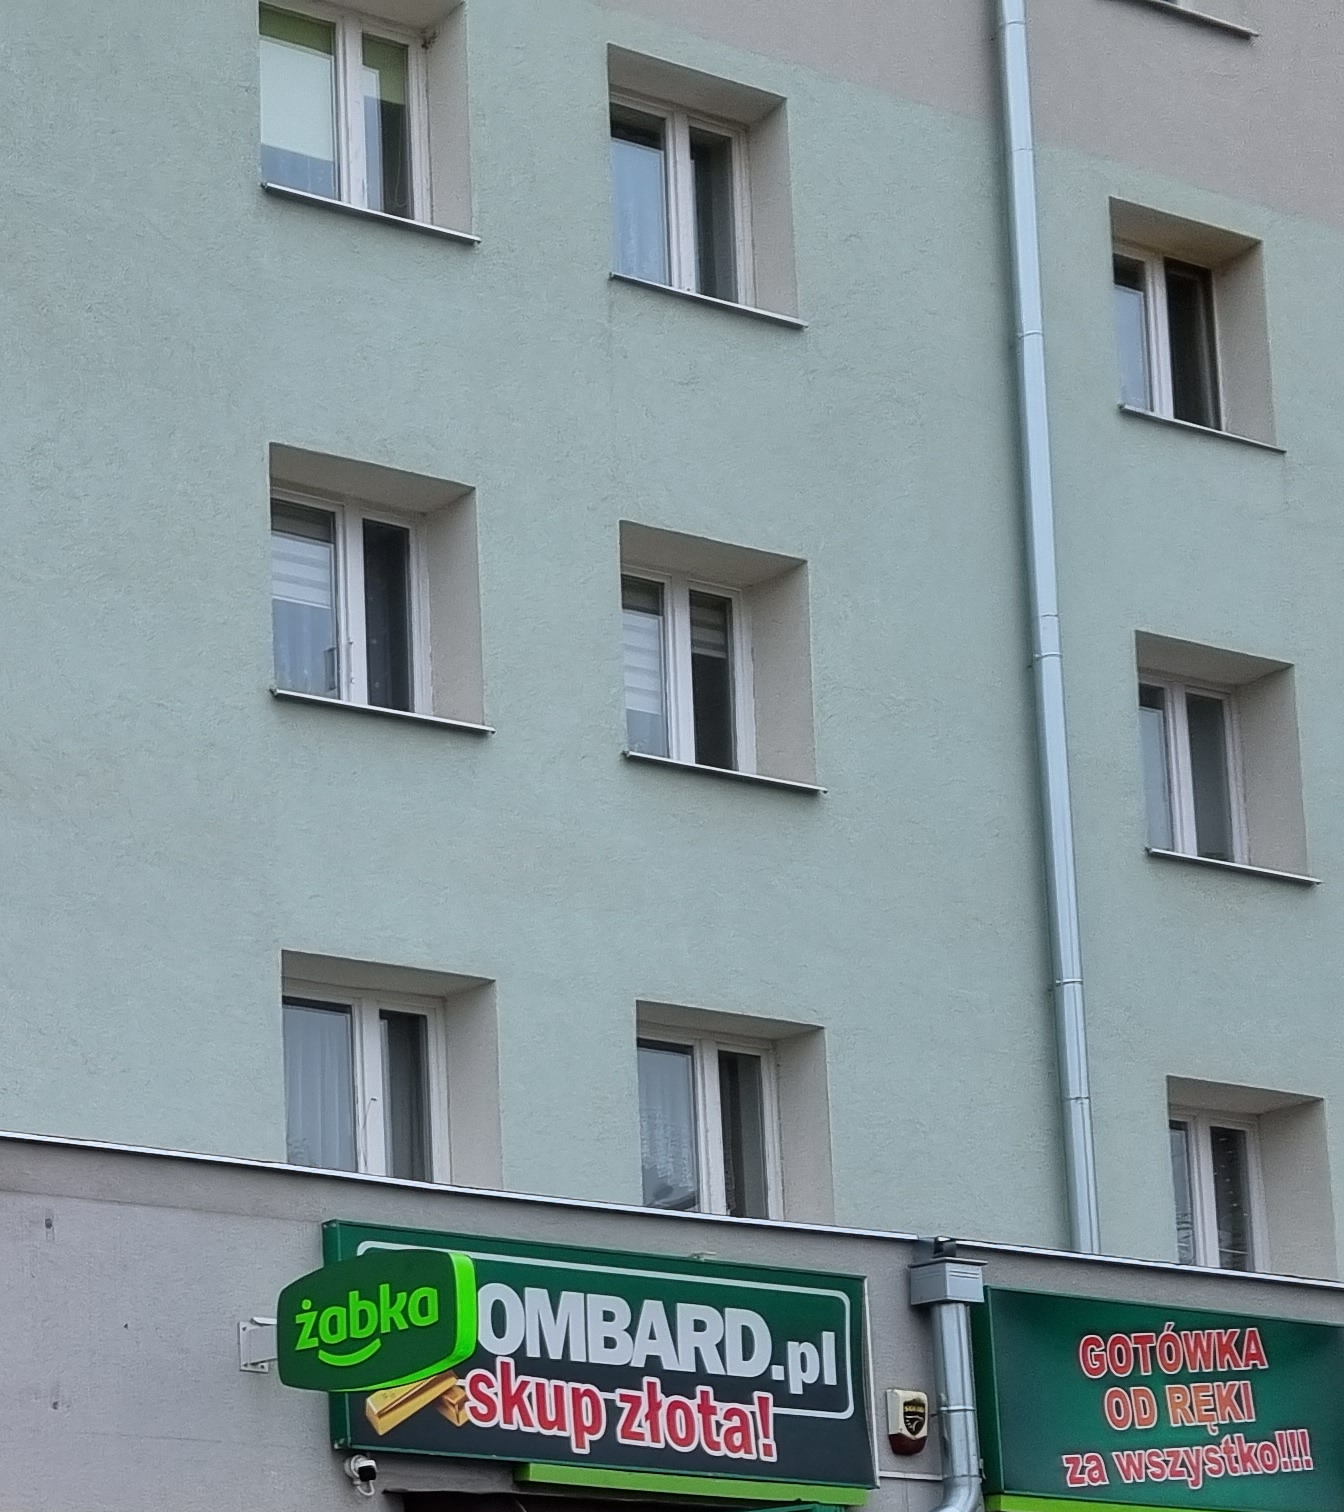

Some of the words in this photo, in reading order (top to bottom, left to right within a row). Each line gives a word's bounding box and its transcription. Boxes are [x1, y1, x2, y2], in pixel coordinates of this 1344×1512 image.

[296, 1283, 439, 1352] żabka
[477, 1283, 838, 1394] OMBARD.pl
[1080, 1322, 1268, 1378] GOTÓWKA
[465, 1357, 606, 1454] skup
[615, 1377, 778, 1463] złota!
[1104, 1386, 1157, 1431] OD
[1166, 1381, 1256, 1435] RĘKI
[1063, 1452, 1109, 1488] za
[1114, 1429, 1314, 1490] wszystko!!!
